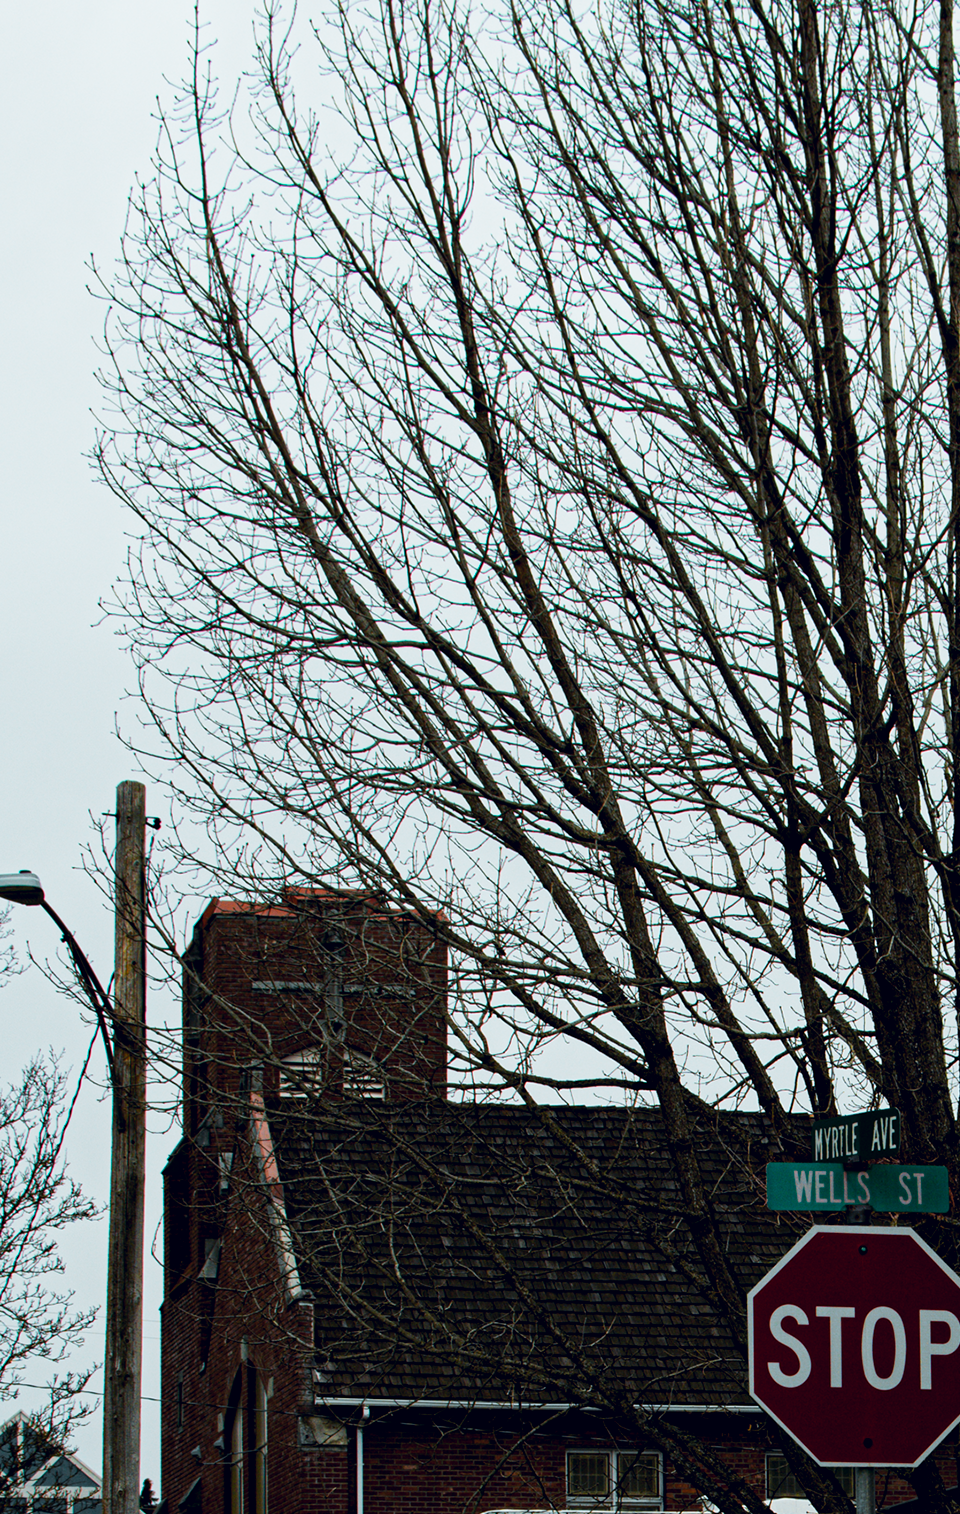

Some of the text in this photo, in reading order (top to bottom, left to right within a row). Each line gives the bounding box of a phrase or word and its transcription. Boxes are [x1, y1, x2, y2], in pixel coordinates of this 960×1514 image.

[814, 1115, 897, 1162] MYRTLE AVE
[793, 1170, 925, 1205] WELLS ST
